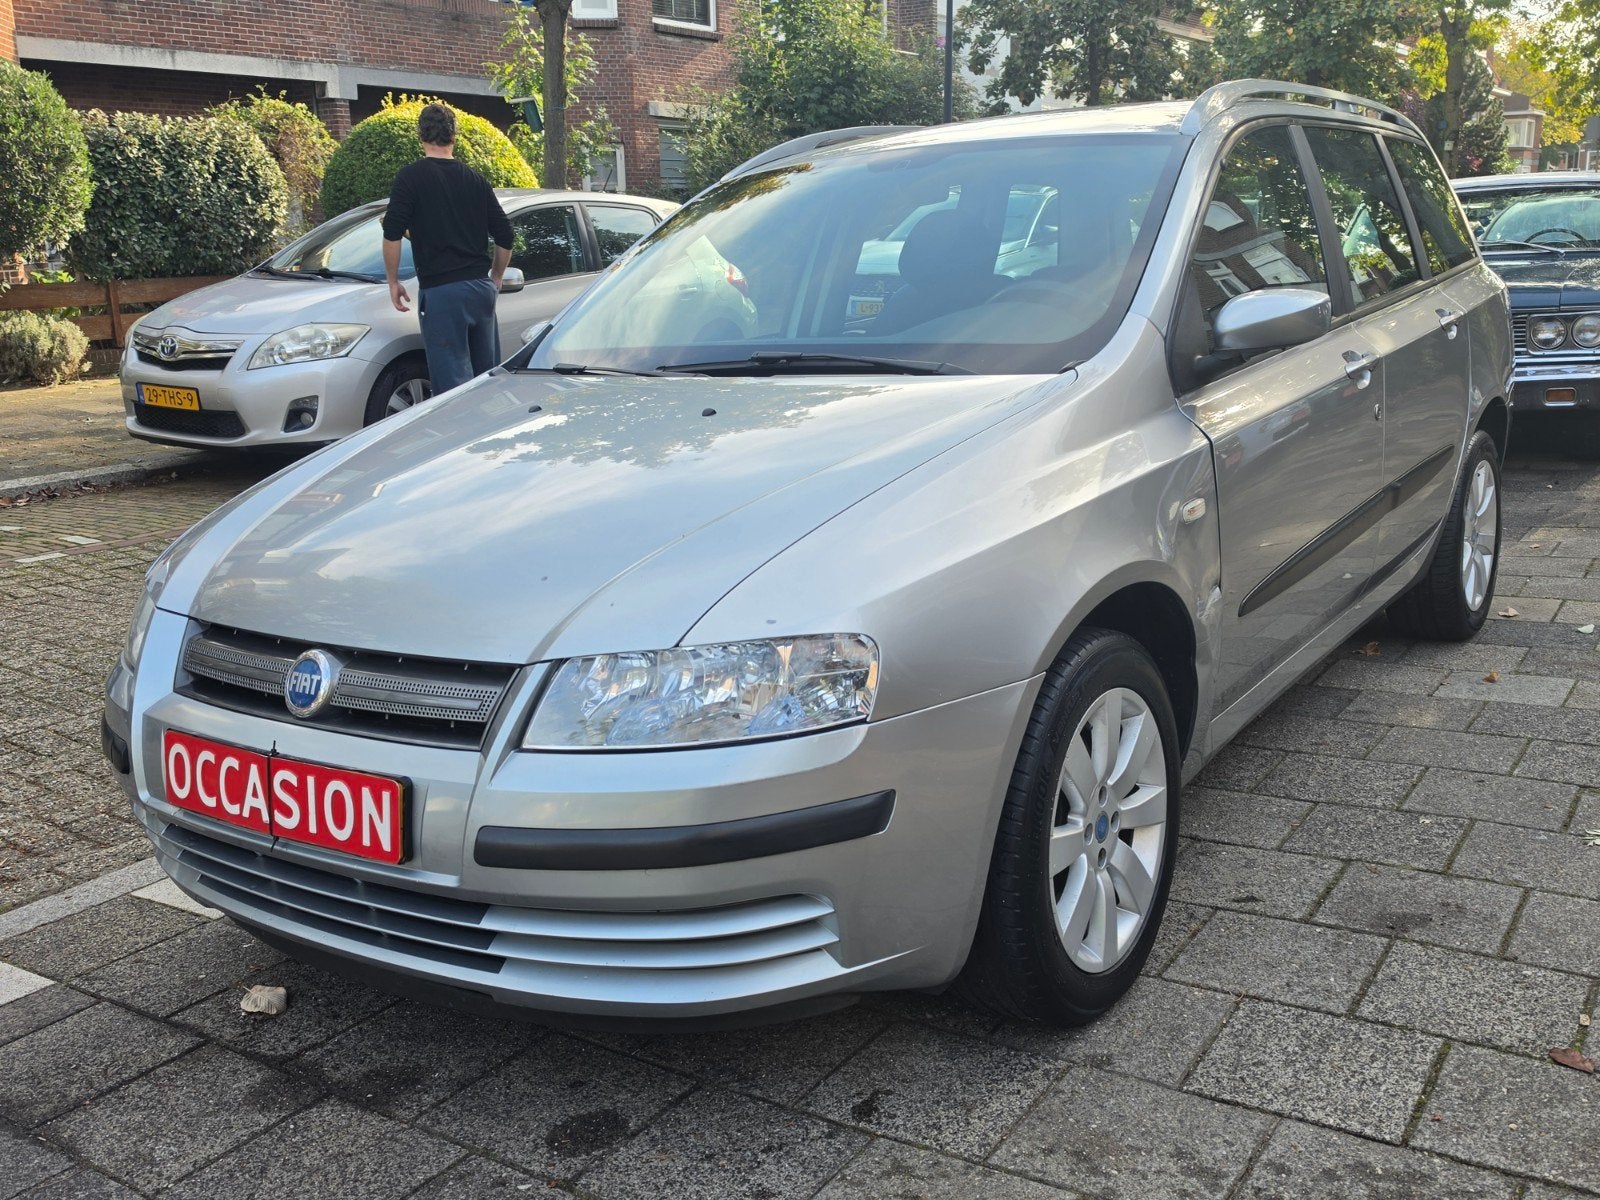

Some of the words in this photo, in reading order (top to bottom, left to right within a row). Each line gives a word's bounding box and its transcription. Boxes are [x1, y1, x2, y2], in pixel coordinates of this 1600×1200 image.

[145, 387, 194, 407] 29-THS-9
[289, 671, 322, 695] FIAT
[168, 743, 392, 853] OCCASION
